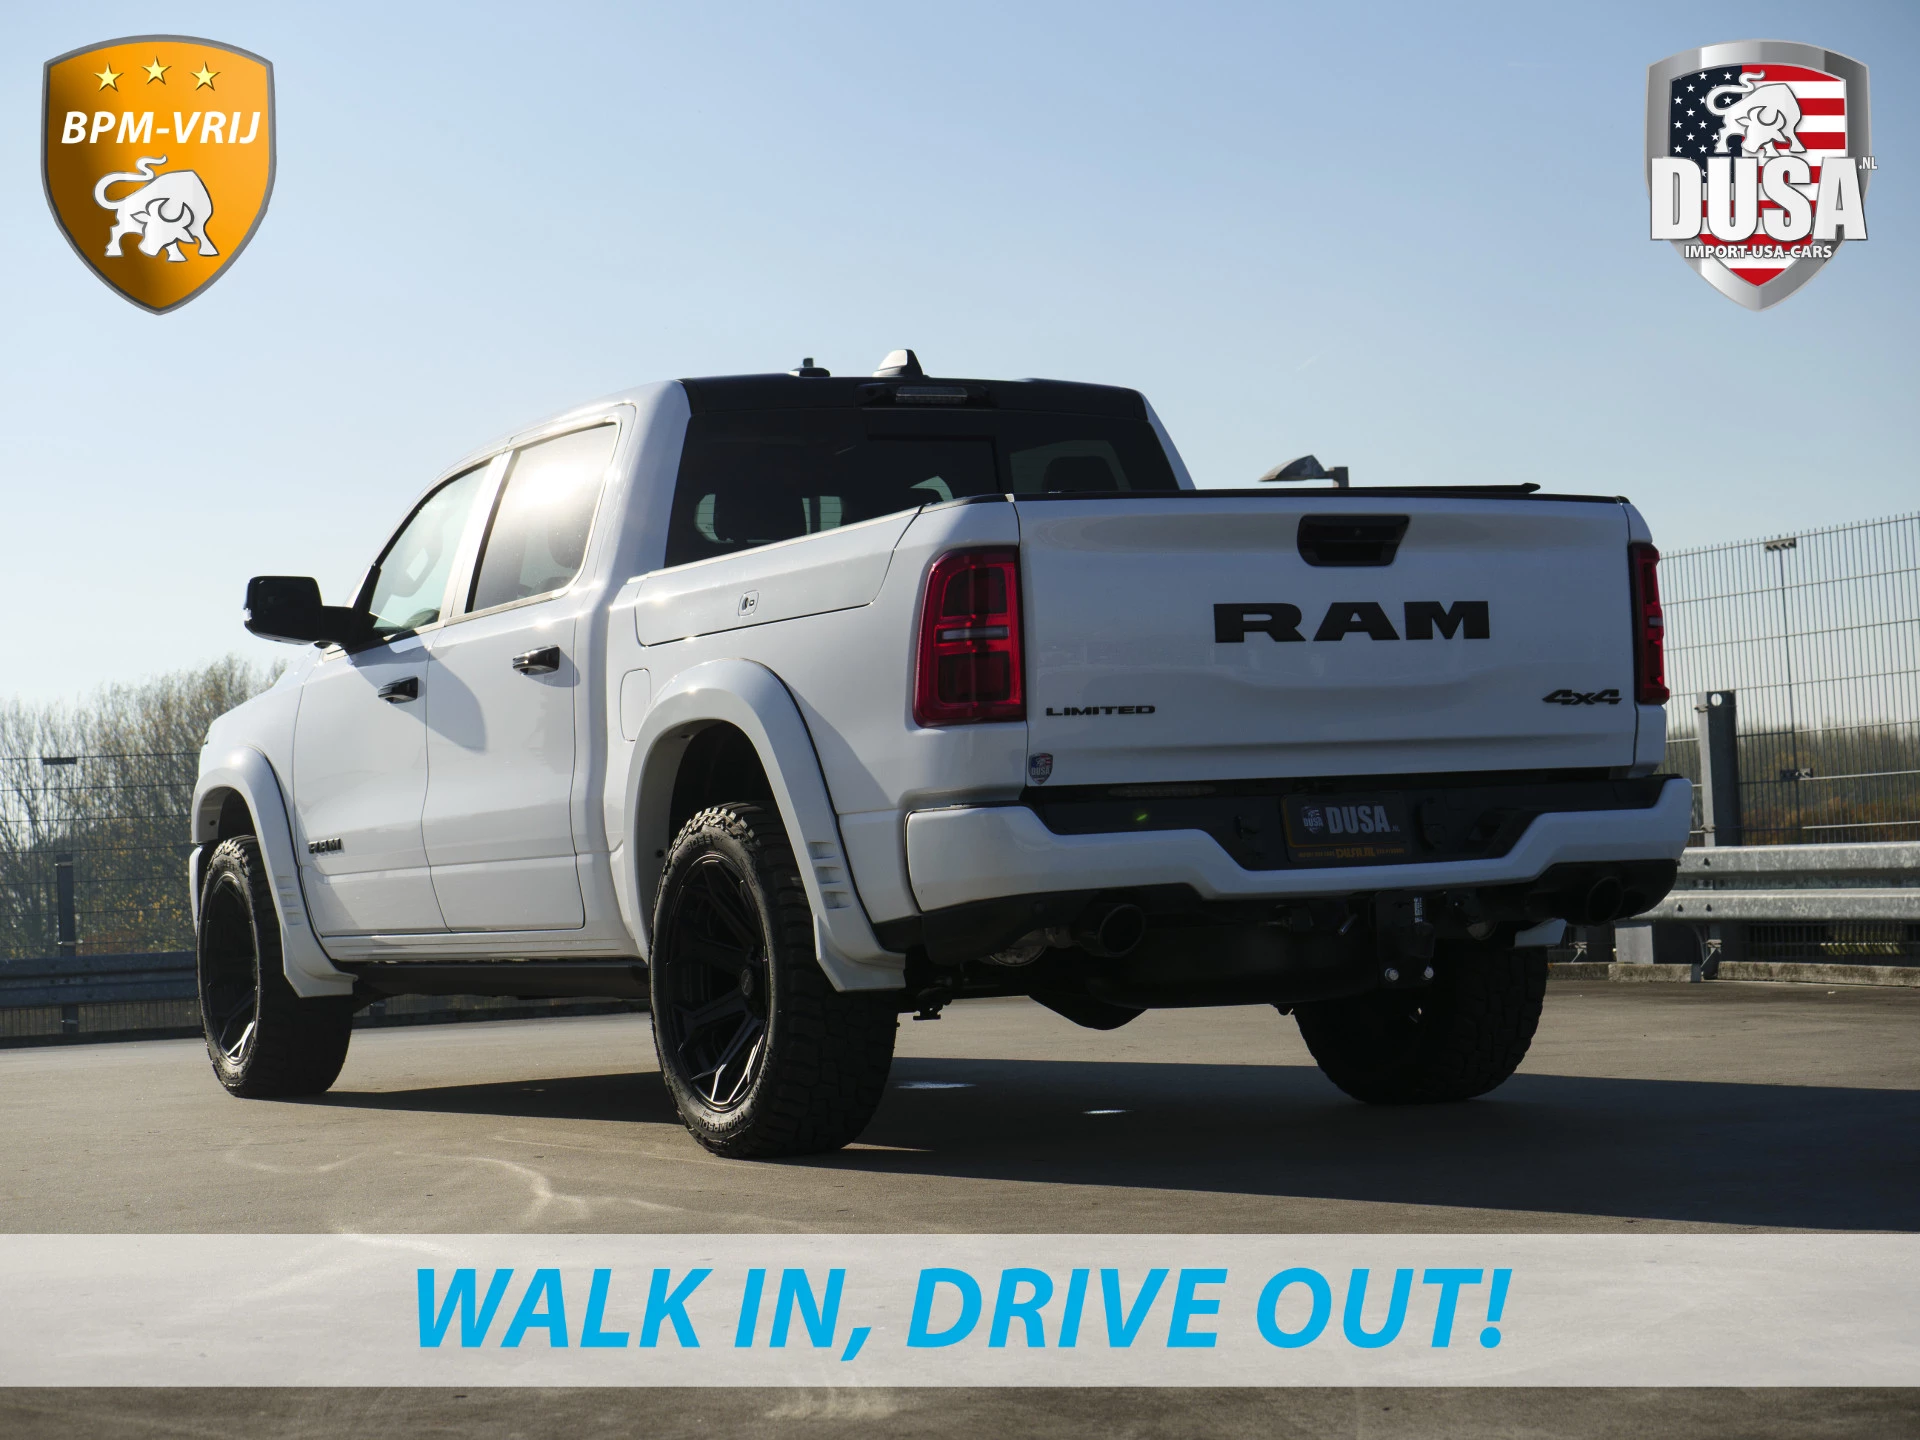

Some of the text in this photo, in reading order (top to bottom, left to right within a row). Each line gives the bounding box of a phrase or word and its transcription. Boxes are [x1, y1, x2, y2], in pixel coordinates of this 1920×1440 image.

[1213, 600, 1490, 643] RAM
[1542, 688, 1622, 705] 4x4
[1046, 705, 1155, 716] LIMITED
[1031, 767, 1050, 775] DUSA
[1303, 817, 1324, 827] DUSA
[1325, 805, 1391, 833] DUSA
[308, 837, 342, 854] RAM
